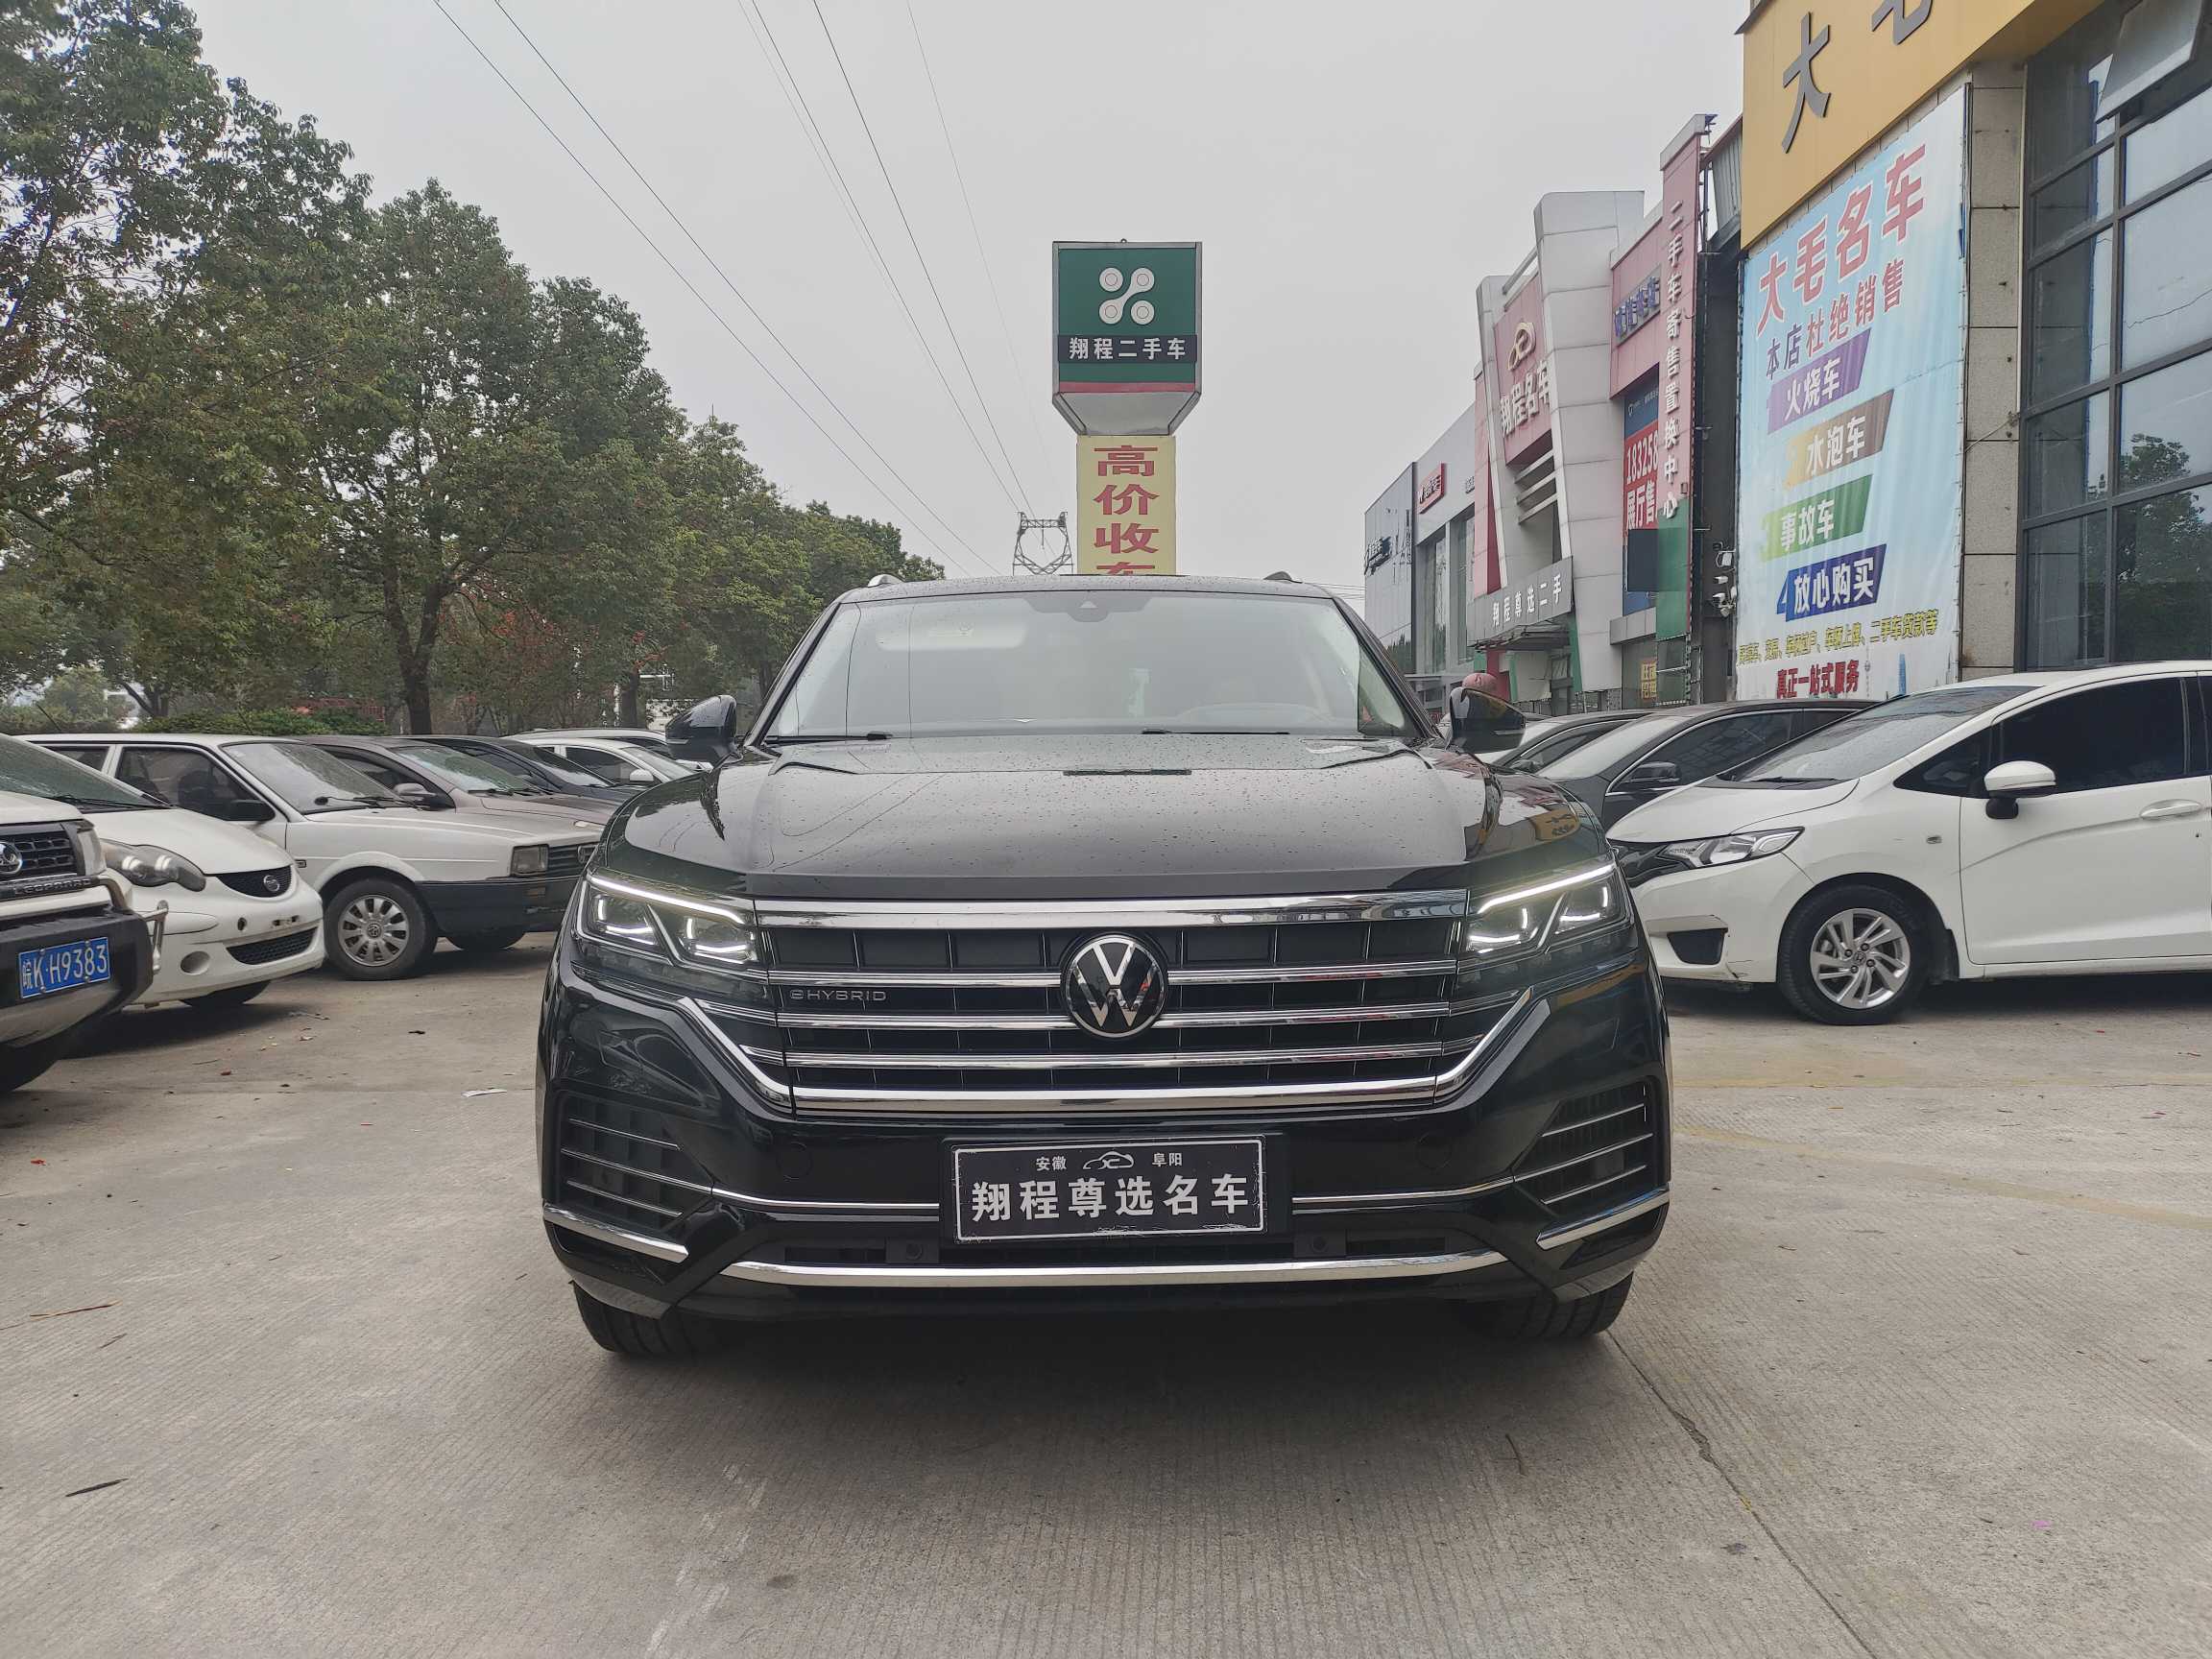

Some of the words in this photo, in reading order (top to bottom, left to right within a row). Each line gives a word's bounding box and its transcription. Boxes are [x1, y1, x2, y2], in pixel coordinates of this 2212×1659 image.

[1758, 144, 1926, 337] 大毛名车
[1767, 259, 1905, 380] 本店杜绝销售
[1069, 337, 1186, 360] 翔程二手车
[1785, 356, 1841, 421] 火烧车
[1806, 415, 1865, 476] 水泡车
[1625, 478, 1659, 531] 展厅售
[1781, 498, 1835, 552] 事故车
[1793, 557, 1874, 614] 放心购买
[1776, 659, 1860, 699] 真正一站式服务
[1036, 1156, 1067, 1171] 安徽
[1151, 1152, 1183, 1167] 阜阳
[972, 1173, 1249, 1222] 翔程尊选名车
